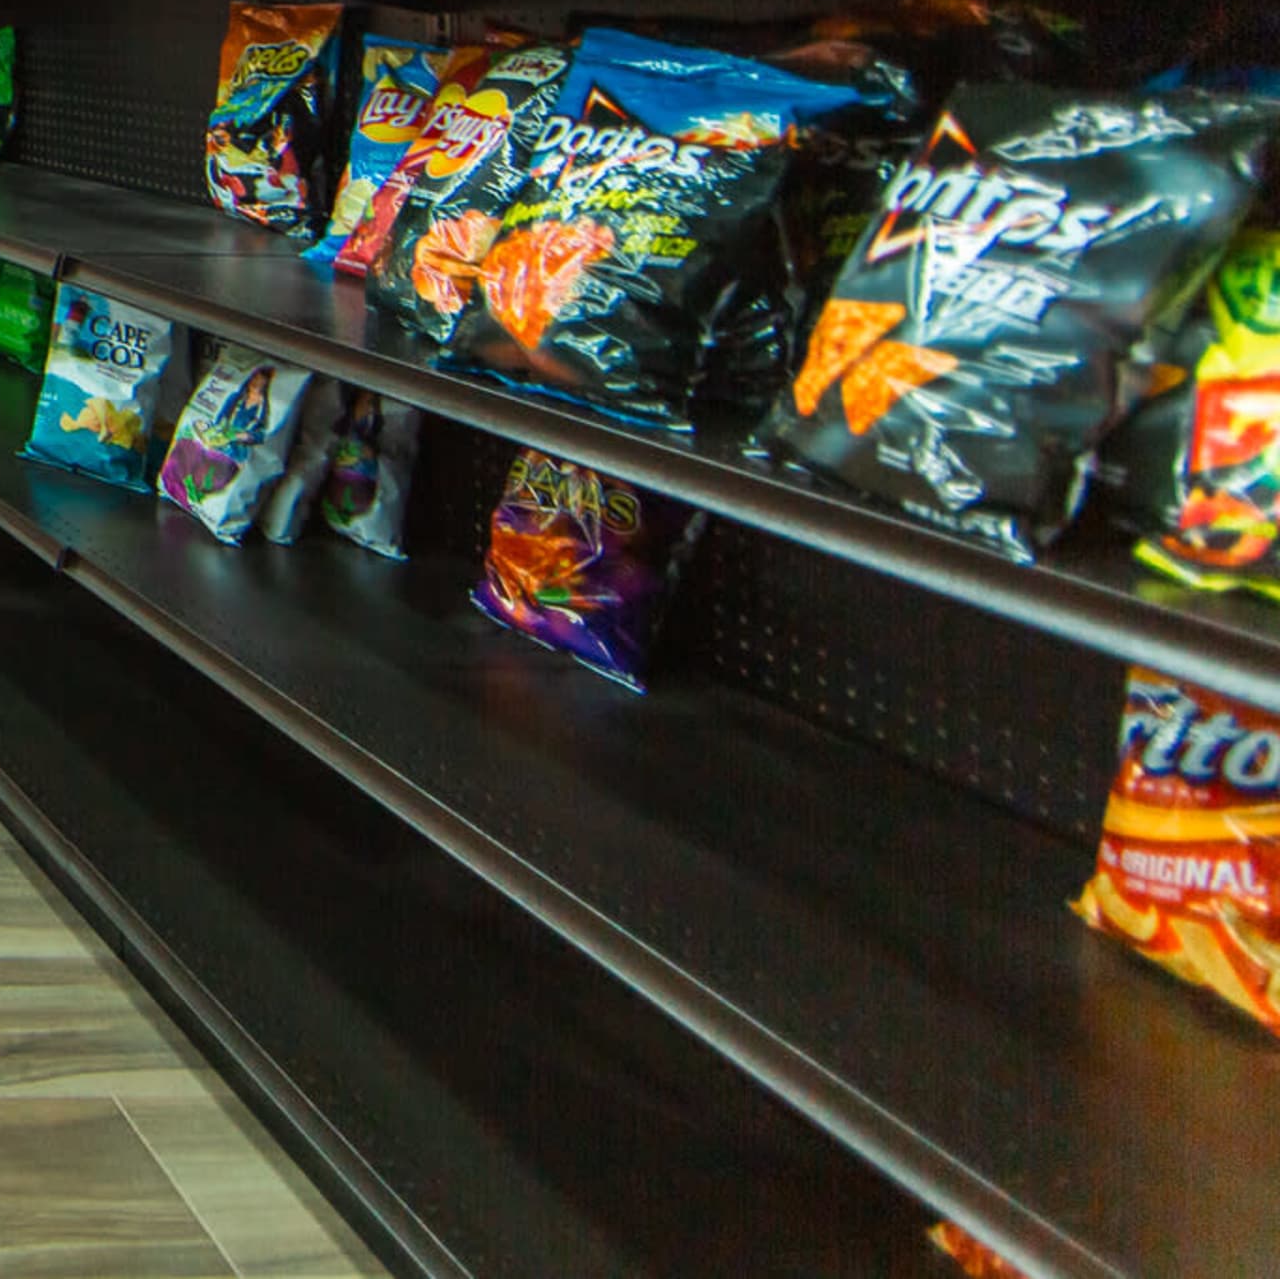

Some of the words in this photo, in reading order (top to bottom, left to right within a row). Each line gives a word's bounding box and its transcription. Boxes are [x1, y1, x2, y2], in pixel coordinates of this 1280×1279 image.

[533, 116, 711, 178] Doritos
[90, 316, 152, 352] CAPE
[92, 339, 145, 370] COD
[1120, 847, 1268, 896] ORIGINAL
